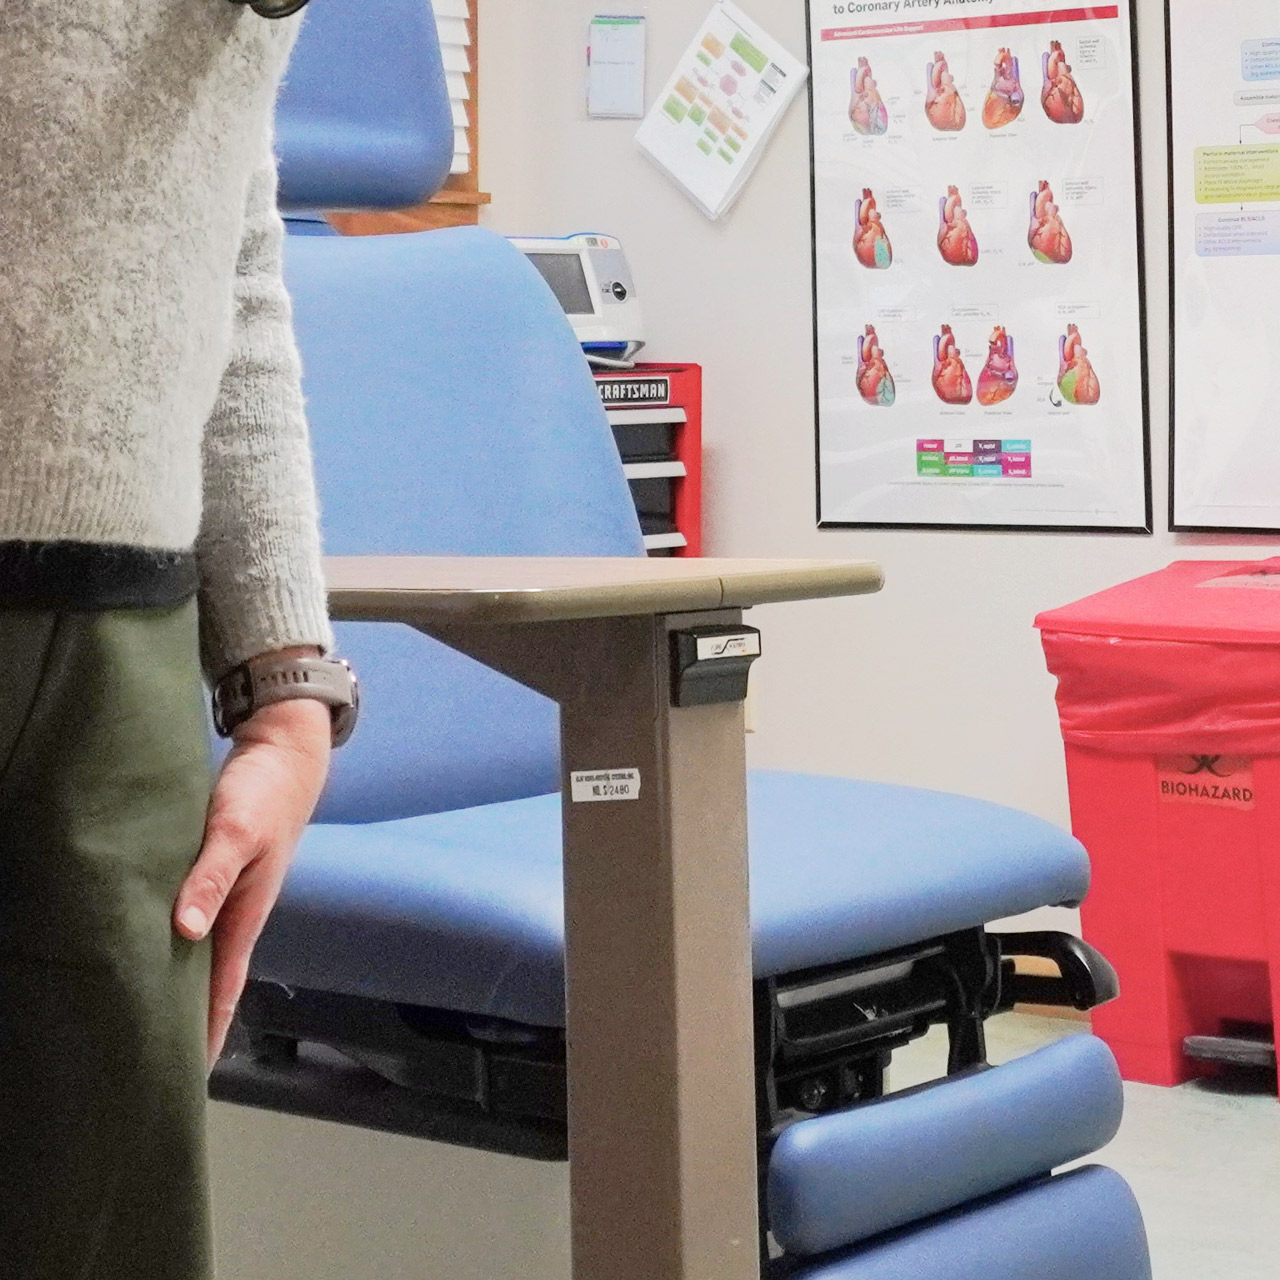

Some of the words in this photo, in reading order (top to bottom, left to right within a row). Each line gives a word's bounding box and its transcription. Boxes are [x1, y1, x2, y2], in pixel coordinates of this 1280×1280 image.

[834, 4, 844, 14] to
[848, 2, 900, 13] Coronary
[598, 384, 665, 399] CRAFTSMAN
[1161, 781, 1253, 802] BIOHAZARD
